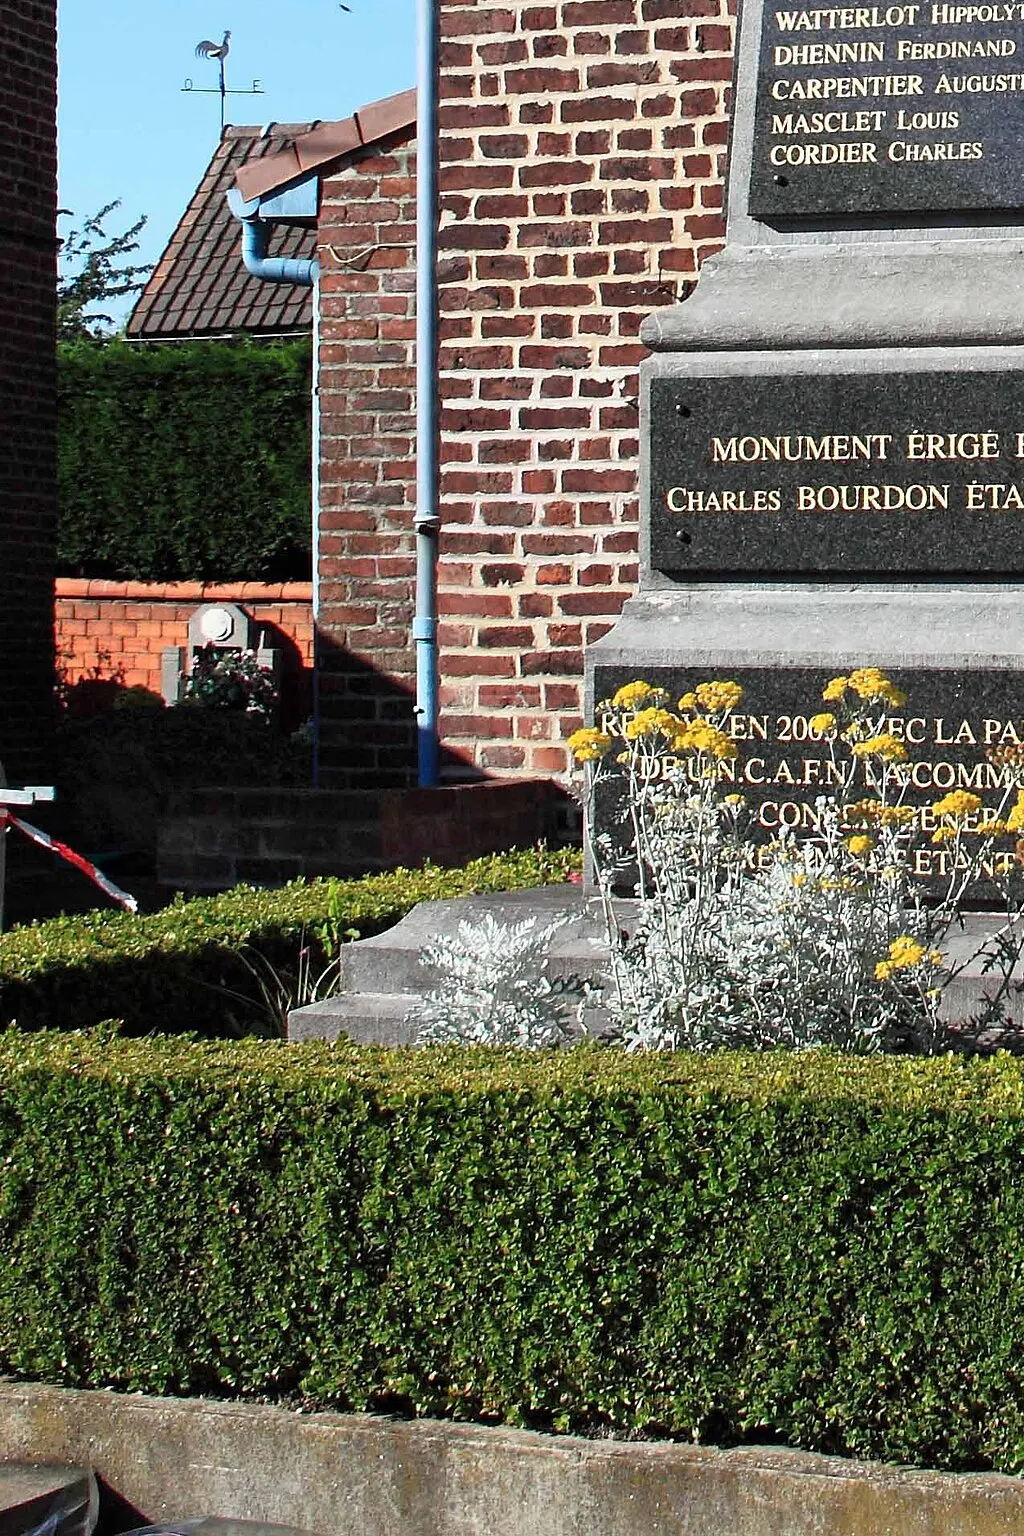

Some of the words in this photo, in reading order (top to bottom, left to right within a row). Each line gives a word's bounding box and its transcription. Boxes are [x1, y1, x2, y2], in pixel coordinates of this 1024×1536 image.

[711, 434, 893, 462] MONUMENT
[796, 484, 950, 511] BOURDON
[729, 714, 769, 740] EN
[846, 716, 926, 744] VEC
[933, 718, 973, 745] LA
